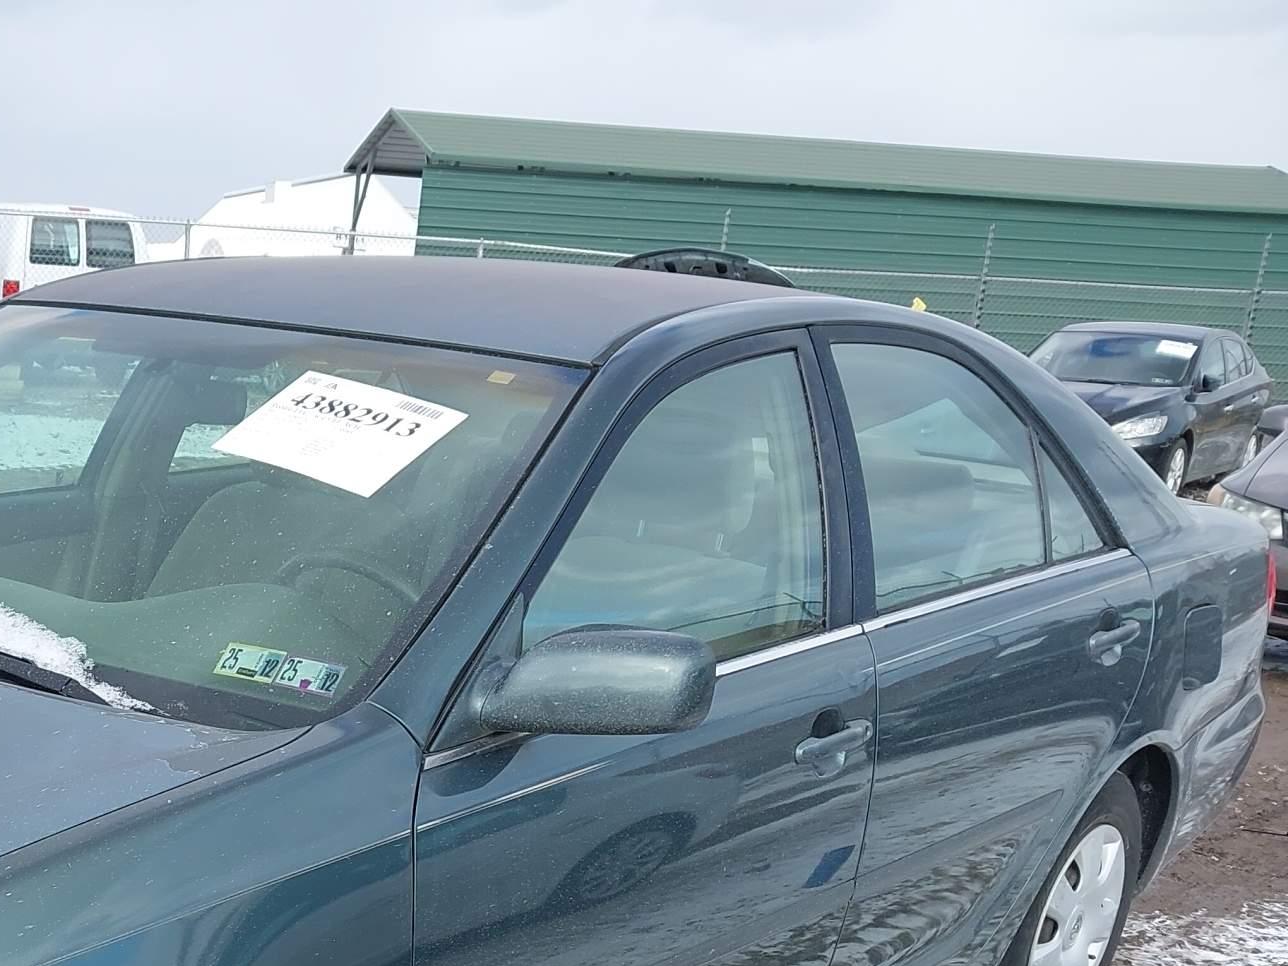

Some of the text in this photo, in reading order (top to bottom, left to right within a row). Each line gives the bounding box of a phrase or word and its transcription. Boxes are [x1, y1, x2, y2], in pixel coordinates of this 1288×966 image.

[290, 391, 422, 438] 43882913
[220, 647, 244, 670] 25
[259, 658, 279, 678] 12
[280, 658, 303, 682] 25
[320, 671, 339, 692] 12
